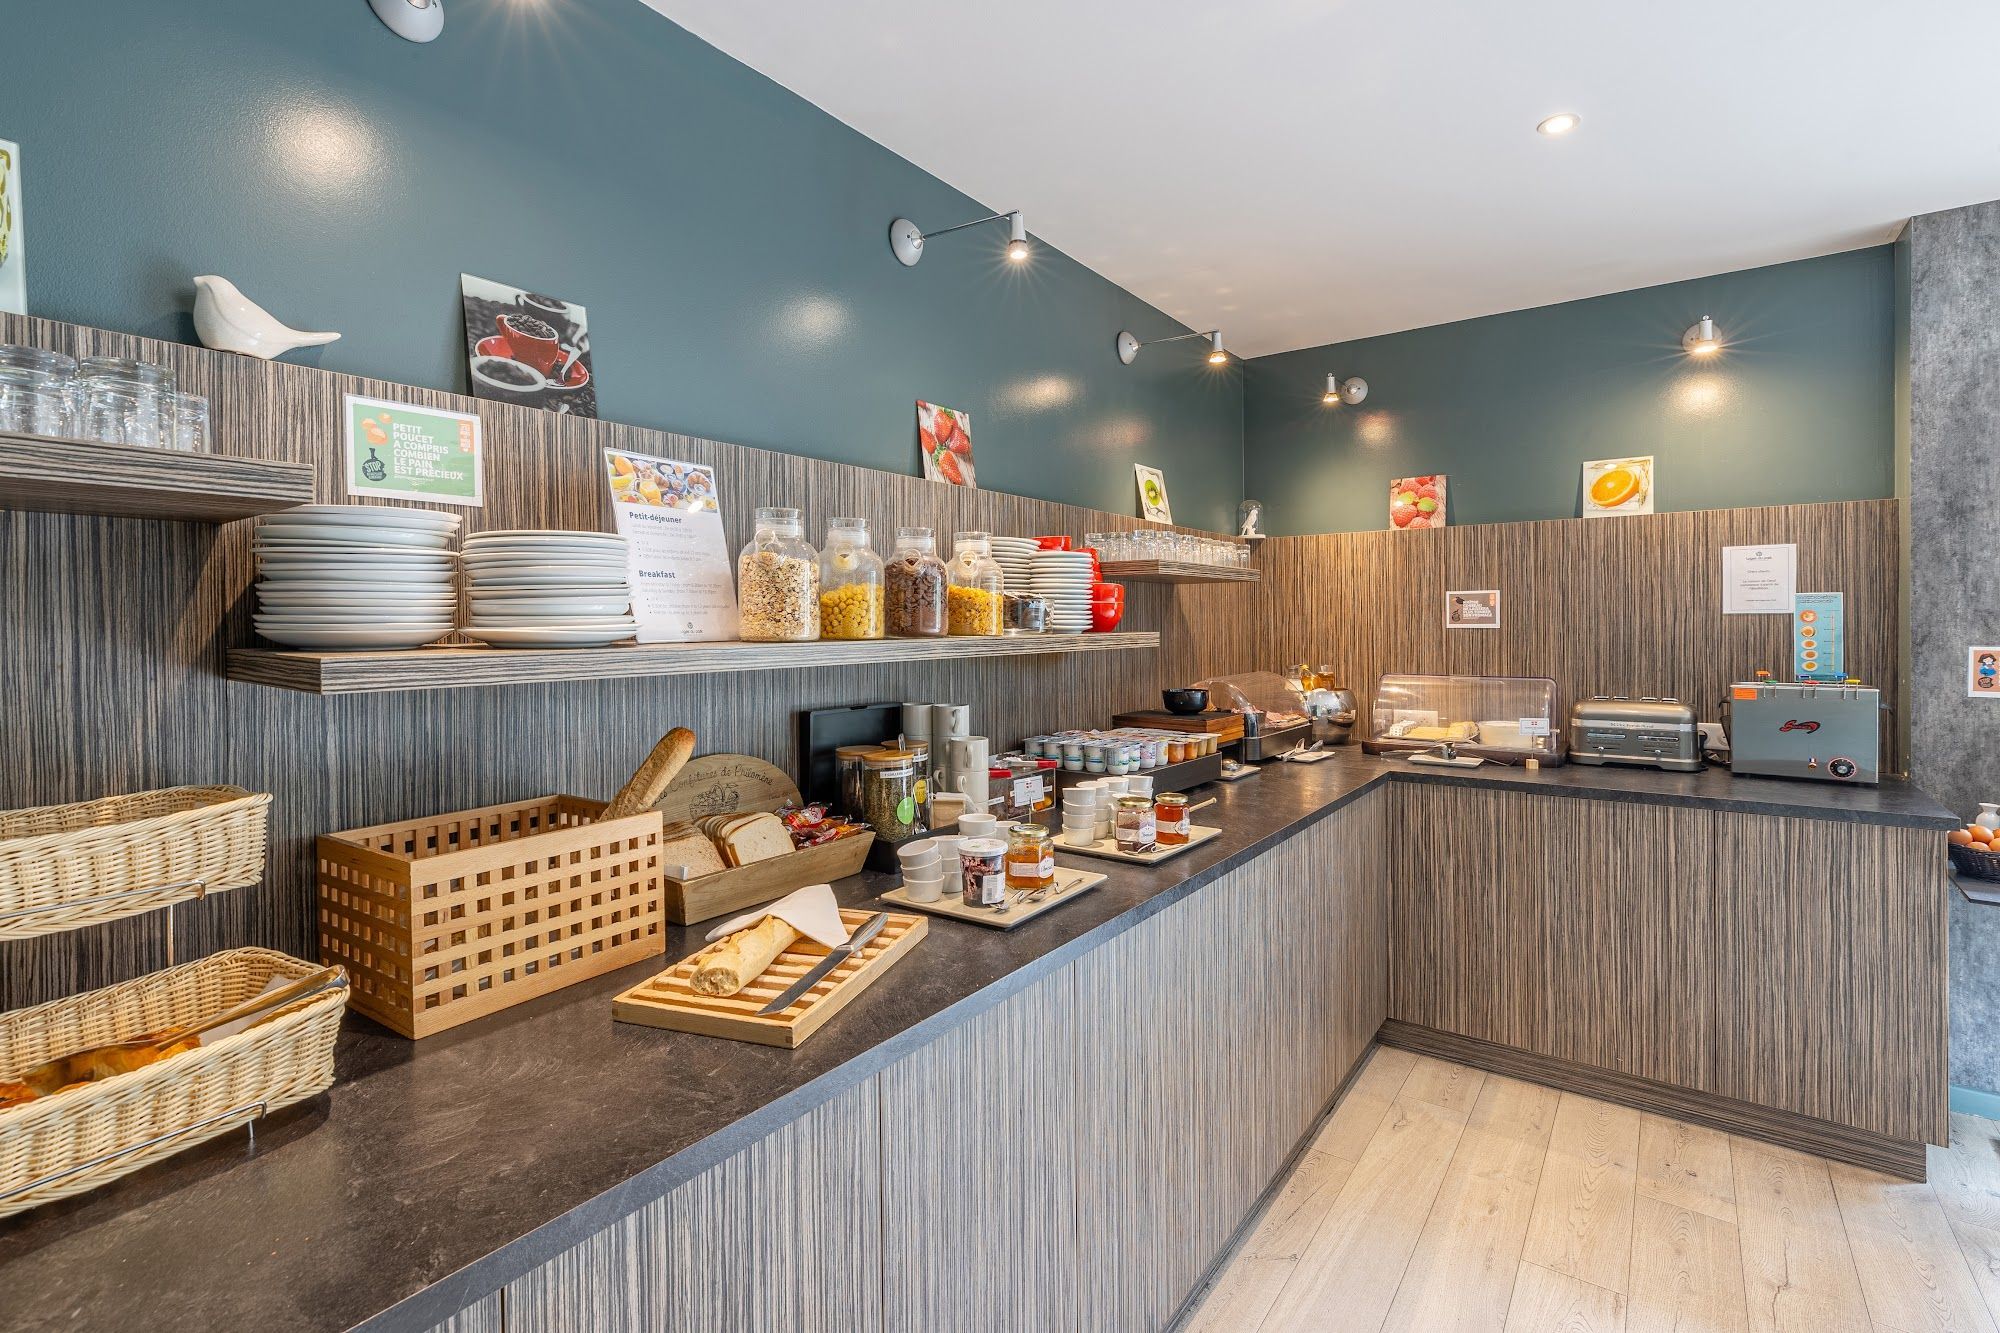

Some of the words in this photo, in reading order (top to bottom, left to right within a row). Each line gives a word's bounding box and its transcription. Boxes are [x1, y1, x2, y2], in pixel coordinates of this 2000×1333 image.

[393, 422, 422, 434] PETIT
[393, 431, 434, 444] POUCET
[393, 440, 402, 448] A
[403, 441, 449, 455] COMPRIS
[394, 448, 441, 461] COMBIEN
[365, 461, 382, 473] STOP
[394, 457, 407, 466] LE
[408, 459, 434, 469] PAIN
[395, 466, 412, 476] EST
[415, 466, 464, 481] PRÉCIEUX
[629, 511, 683, 525] Petit-déjeuner
[639, 569, 676, 579] Breakfast
[671, 770, 718, 793] Confitures
[720, 766, 732, 777] de
[734, 763, 774, 786] Philomène
